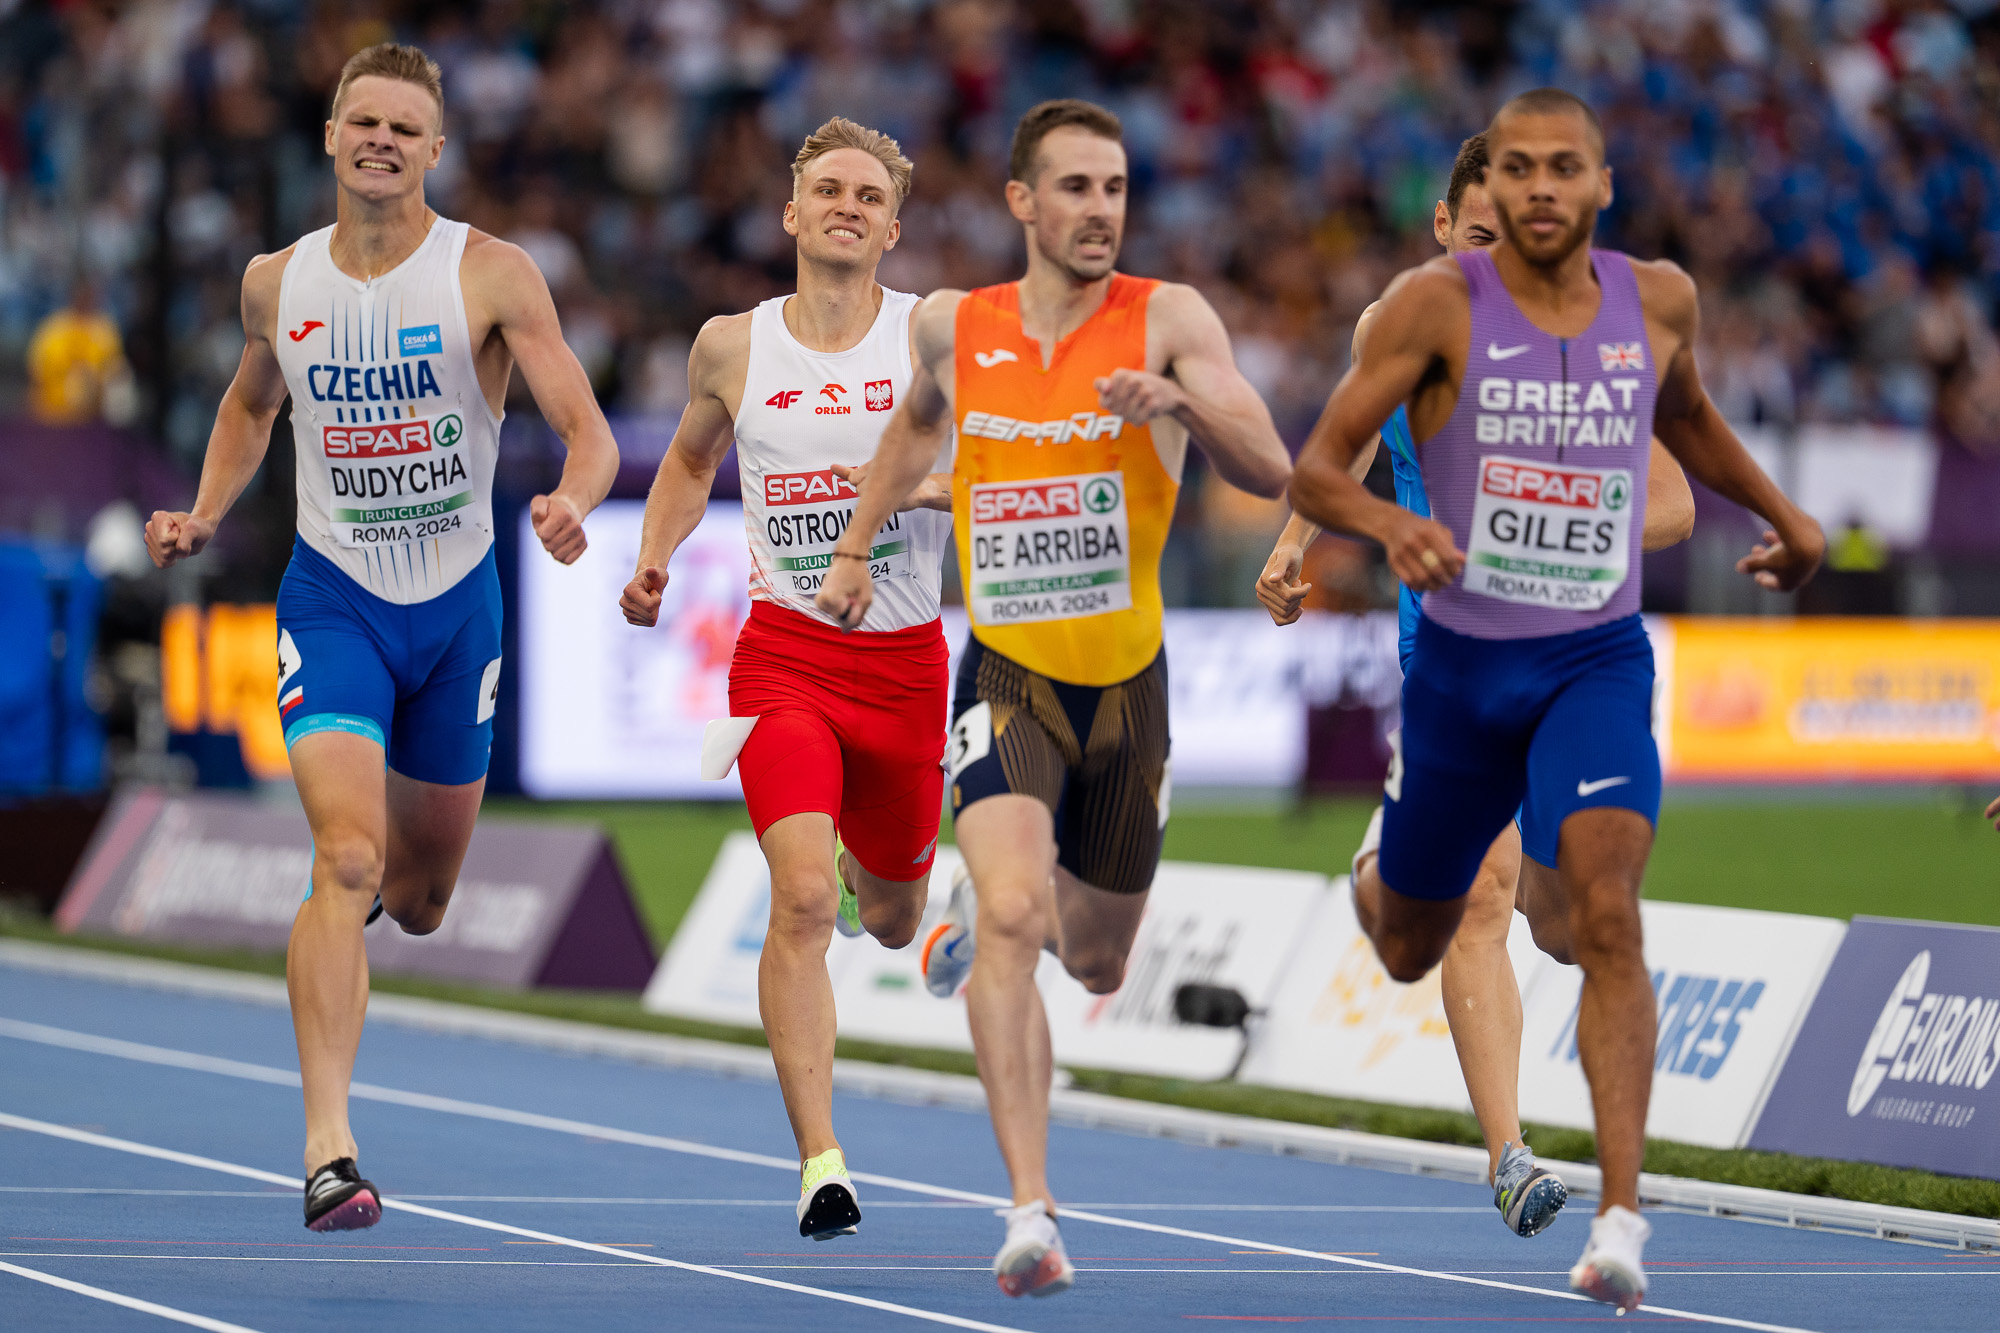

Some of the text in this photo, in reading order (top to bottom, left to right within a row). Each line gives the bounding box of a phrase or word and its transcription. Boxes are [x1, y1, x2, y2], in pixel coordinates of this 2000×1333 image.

[308, 360, 442, 402] CZECHIA
[1478, 377, 1640, 413] GREAT
[765, 390, 803, 409] 4F
[815, 406, 851, 415] ORLEN
[326, 426, 428, 455] SPAR
[961, 410, 1124, 446] ESPAÑA
[1475, 415, 1637, 447] BRITAIN
[331, 453, 467, 498] DUDYCHA
[1485, 465, 1599, 505] SPAR
[366, 508, 396, 522] RUN
[975, 485, 1079, 521] SPAR
[353, 515, 461, 543] ROMA 2024
[1489, 509, 1615, 555] GILES
[975, 523, 1122, 570] DE ARRIBA
[799, 555, 828, 569] RUN
[792, 574, 827, 591] ROM
[1487, 573, 1551, 600] ROMA
[992, 590, 1109, 619] ROMA 2024
[1932, 1102, 1976, 1129] GROUP
